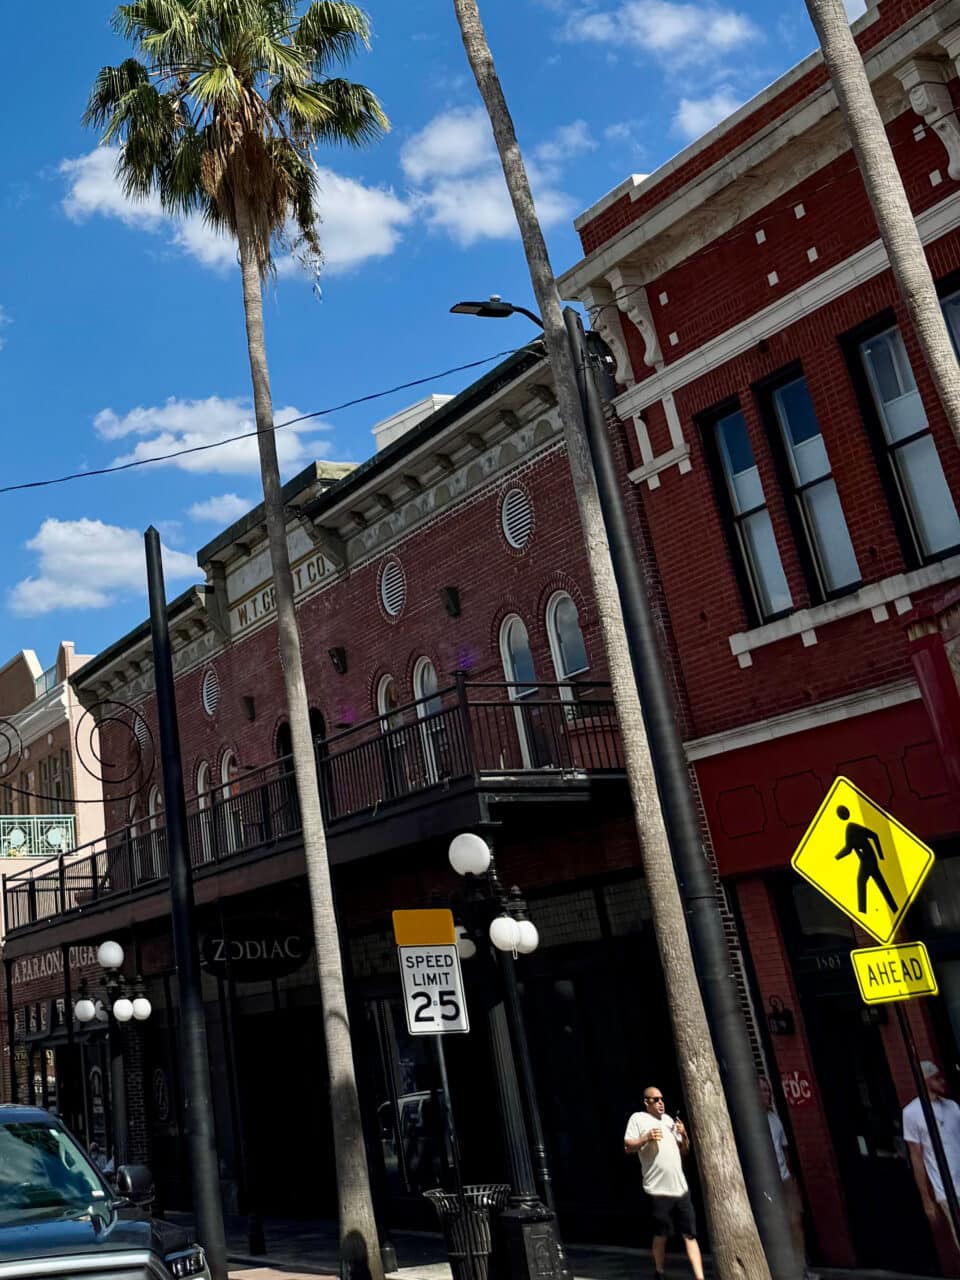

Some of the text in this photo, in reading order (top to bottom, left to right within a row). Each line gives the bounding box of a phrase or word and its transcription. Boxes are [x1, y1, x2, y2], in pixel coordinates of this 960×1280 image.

[211, 936, 302, 961] ZODIAC
[405, 954, 454, 969] SPEED
[867, 957, 924, 988] AHEAD
[412, 972, 451, 987] LIMIT
[410, 990, 461, 1023] 25
